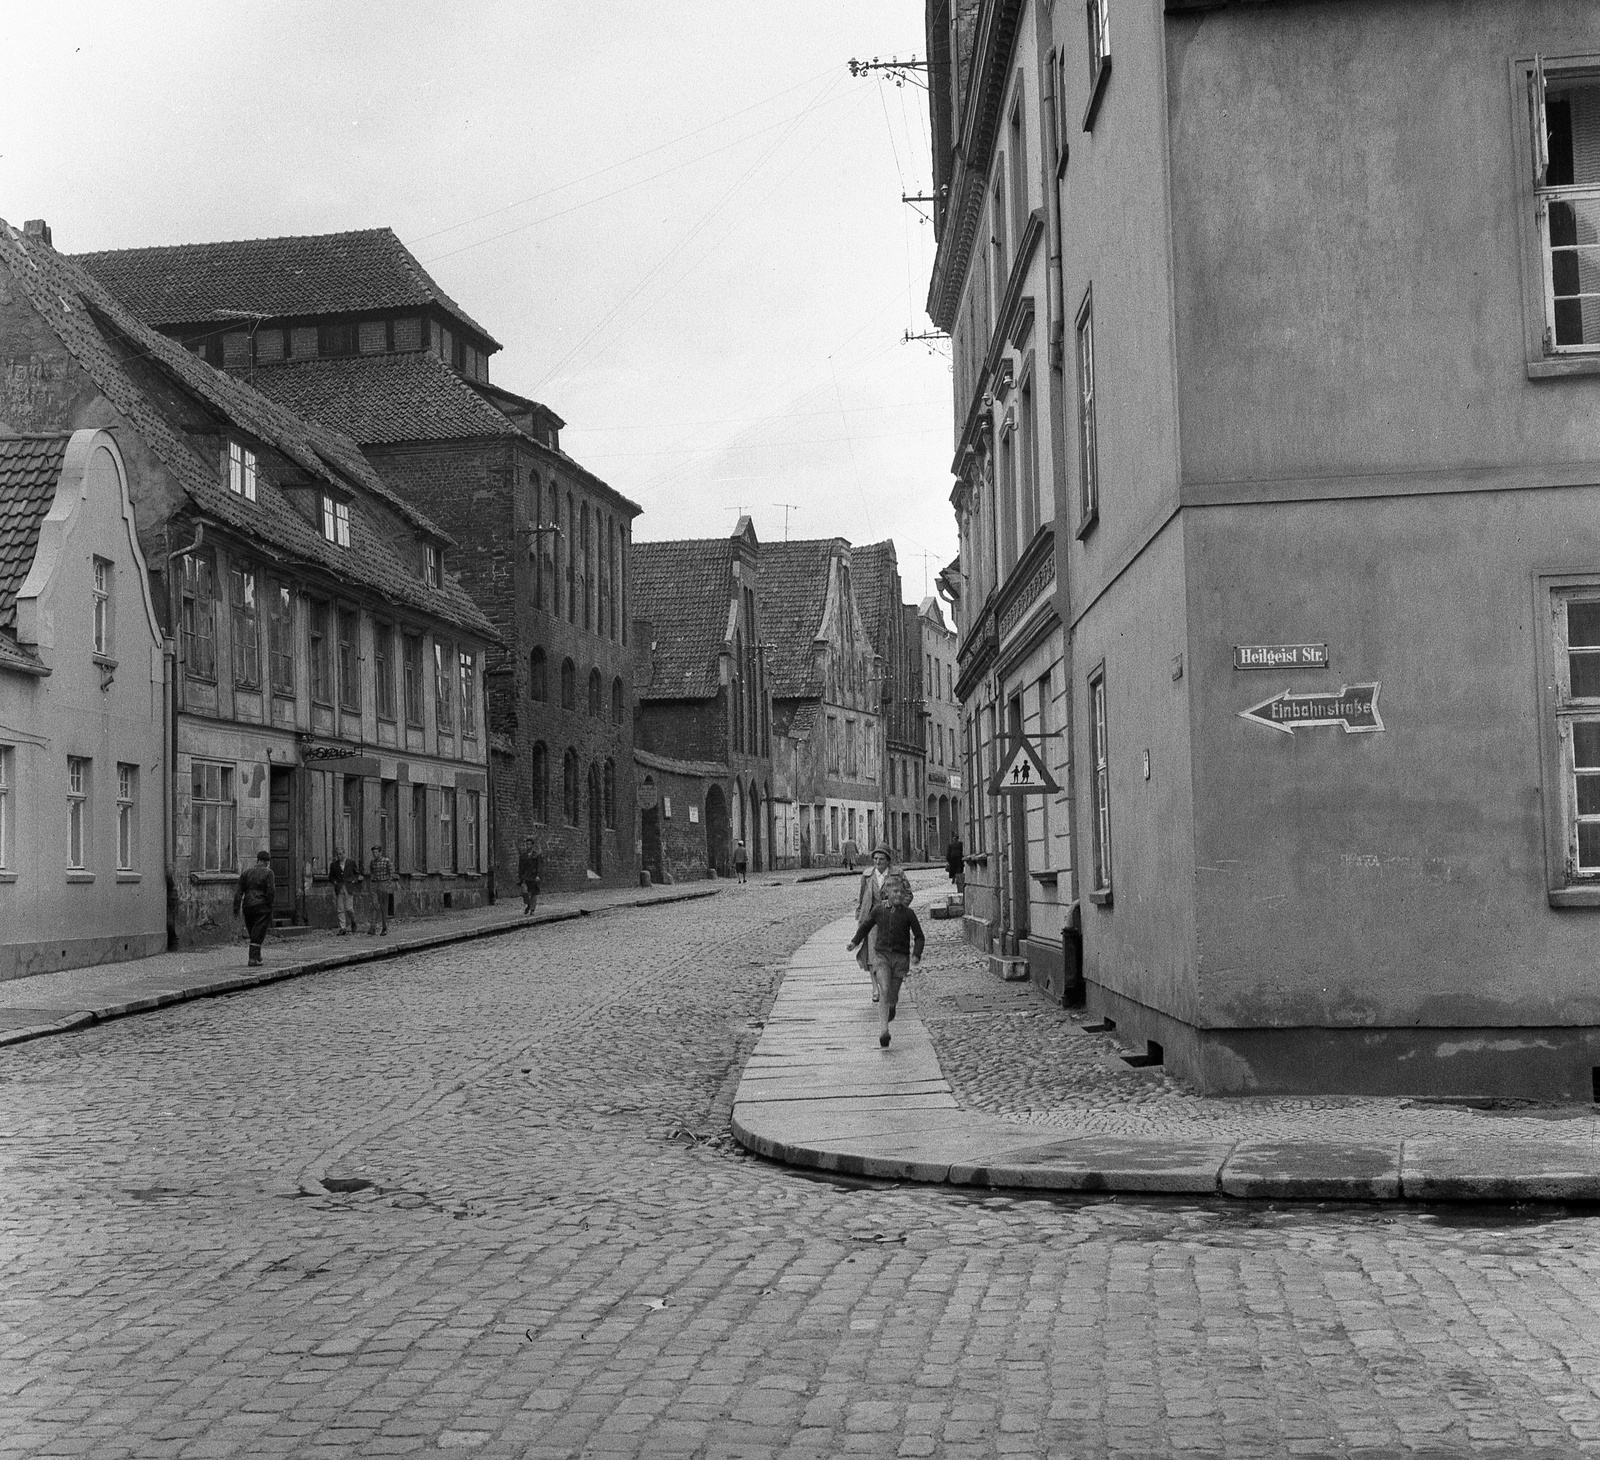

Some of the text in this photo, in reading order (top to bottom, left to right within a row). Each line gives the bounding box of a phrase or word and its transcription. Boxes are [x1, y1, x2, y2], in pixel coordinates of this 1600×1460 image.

[1240, 647, 1323, 666] Heilgeist Str.
[1271, 699, 1371, 718] Einbahnstraße
